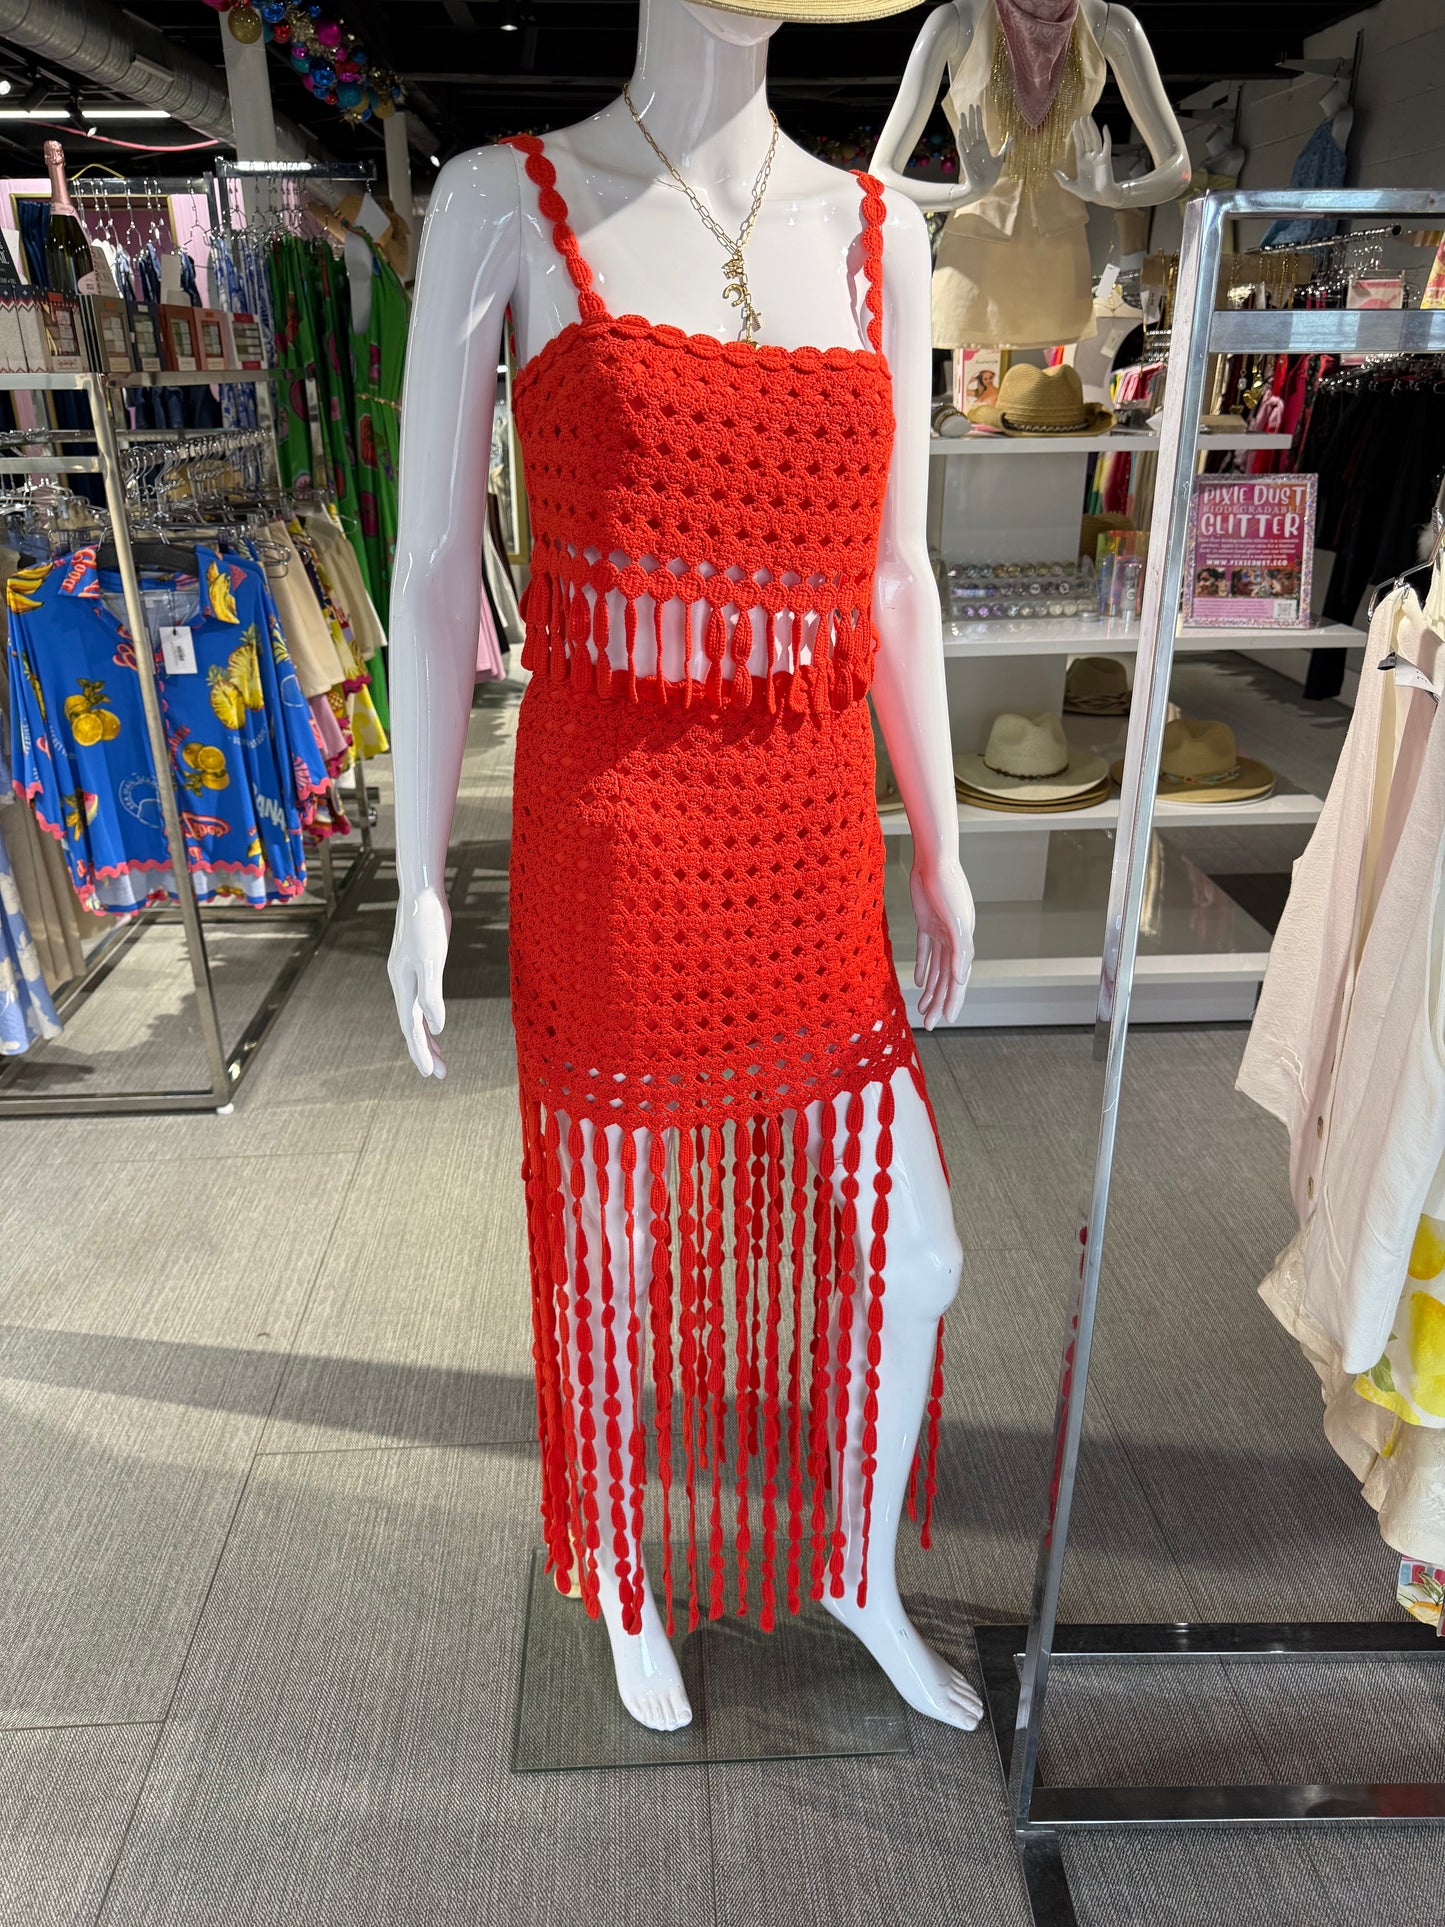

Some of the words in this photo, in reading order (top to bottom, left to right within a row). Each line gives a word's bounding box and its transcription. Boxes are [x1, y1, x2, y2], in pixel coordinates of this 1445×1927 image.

[1203, 486, 1248, 505] PIXIE
[1253, 485, 1306, 506] DUST
[1203, 506, 1304, 514] BIODEGRADABLE
[1201, 513, 1299, 538] GLITTER
